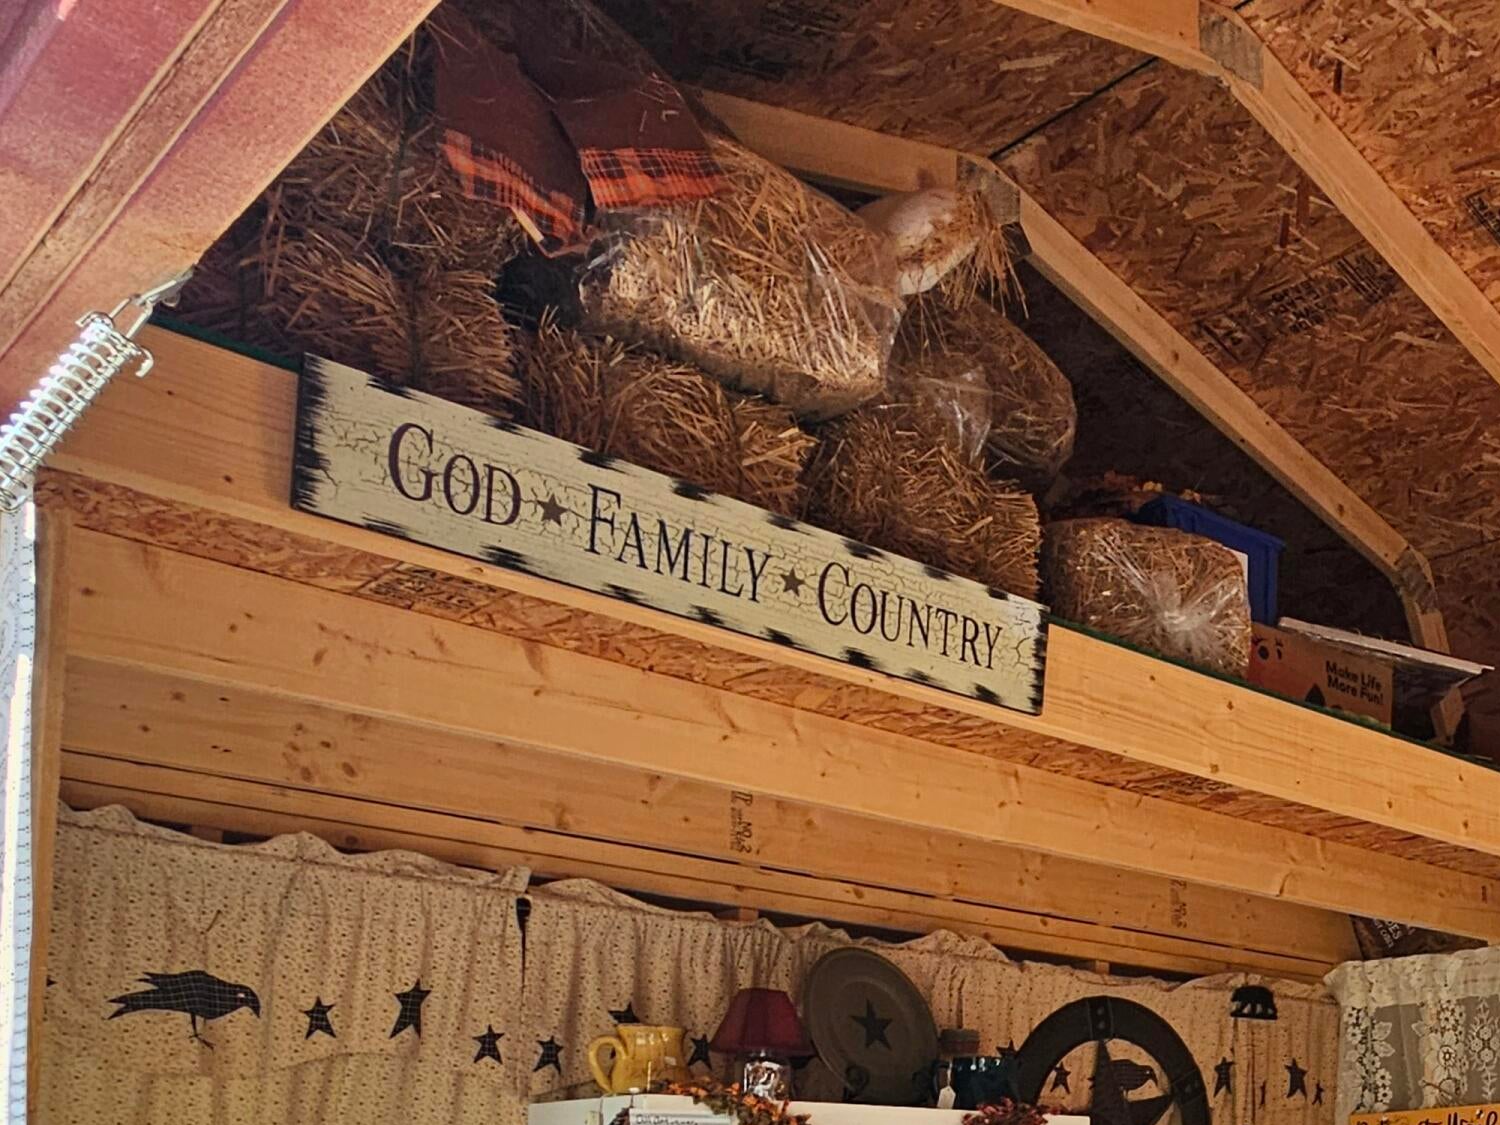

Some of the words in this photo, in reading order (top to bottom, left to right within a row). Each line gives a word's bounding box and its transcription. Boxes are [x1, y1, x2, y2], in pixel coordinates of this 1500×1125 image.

[388, 421, 523, 527] GOD
[585, 482, 772, 604] FAMILY
[816, 561, 1004, 670] COUNTRY
[1325, 660, 1359, 683] Make
[1361, 673, 1382, 691] Life
[1327, 675, 1358, 696] More
[1360, 686, 1384, 705] Fun!
